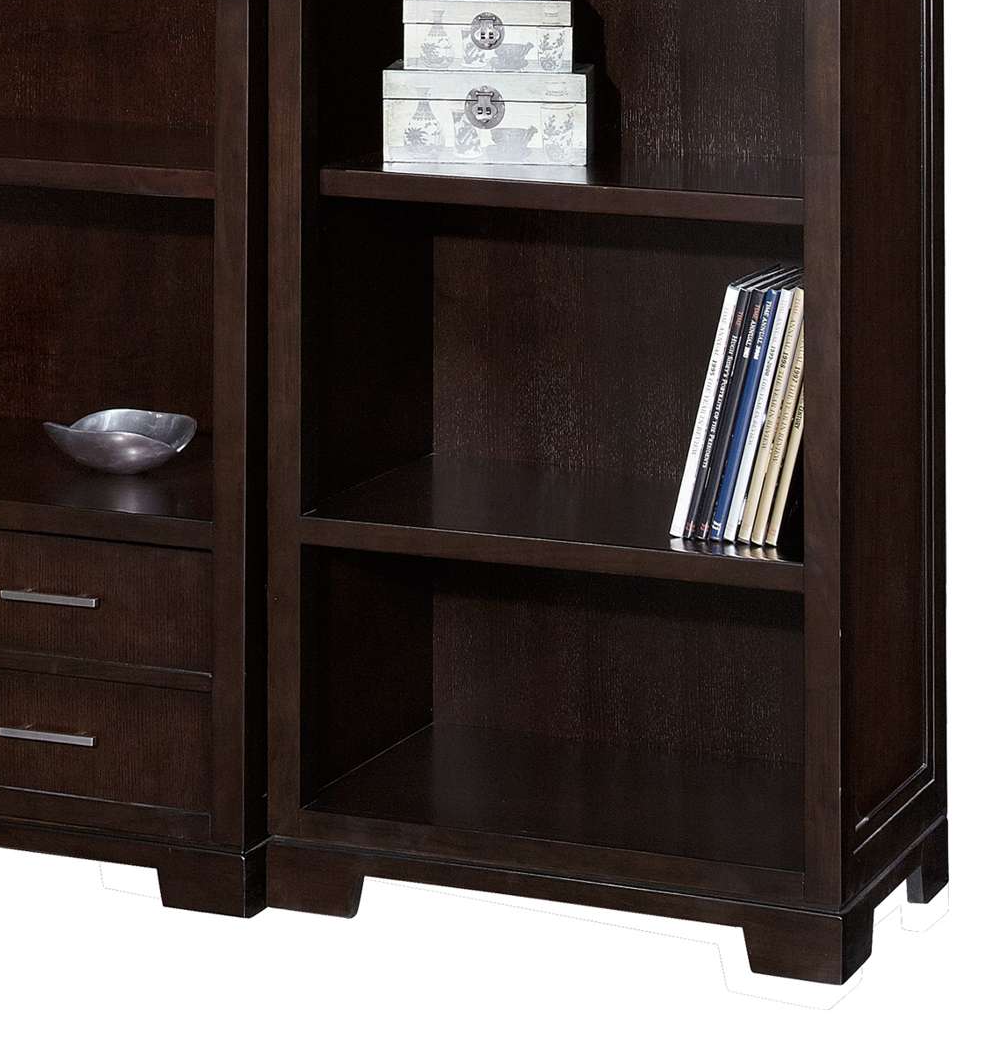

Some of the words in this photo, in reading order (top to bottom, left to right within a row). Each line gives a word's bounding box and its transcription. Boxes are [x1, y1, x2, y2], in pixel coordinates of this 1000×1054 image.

[746, 319, 756, 346] ANNUAL
[758, 317, 767, 344] ANNUAL
[792, 366, 800, 382] 1997
